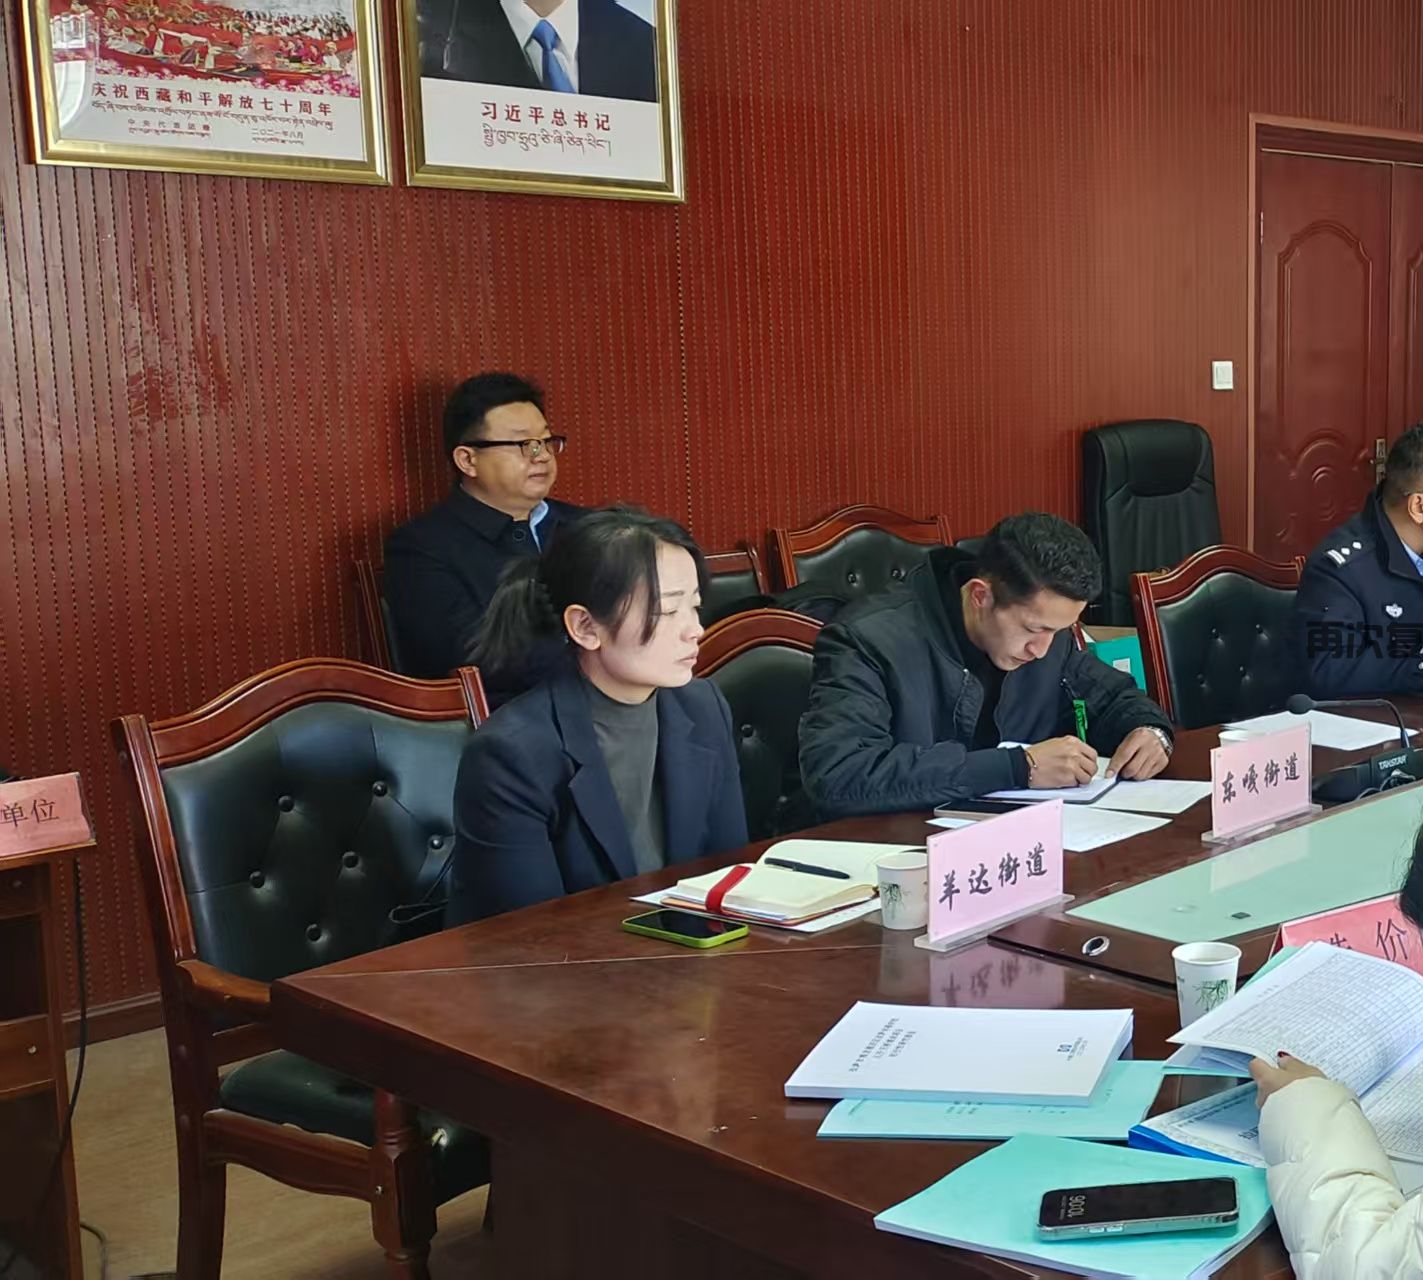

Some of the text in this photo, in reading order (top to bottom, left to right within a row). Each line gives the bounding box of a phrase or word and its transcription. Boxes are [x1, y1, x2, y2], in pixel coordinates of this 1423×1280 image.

[91, 82, 332, 116] 庆祝西藏和平解放七十周年
[481, 101, 611, 131] 习近平总书记
[939, 842, 1048, 911] 羊达街道
